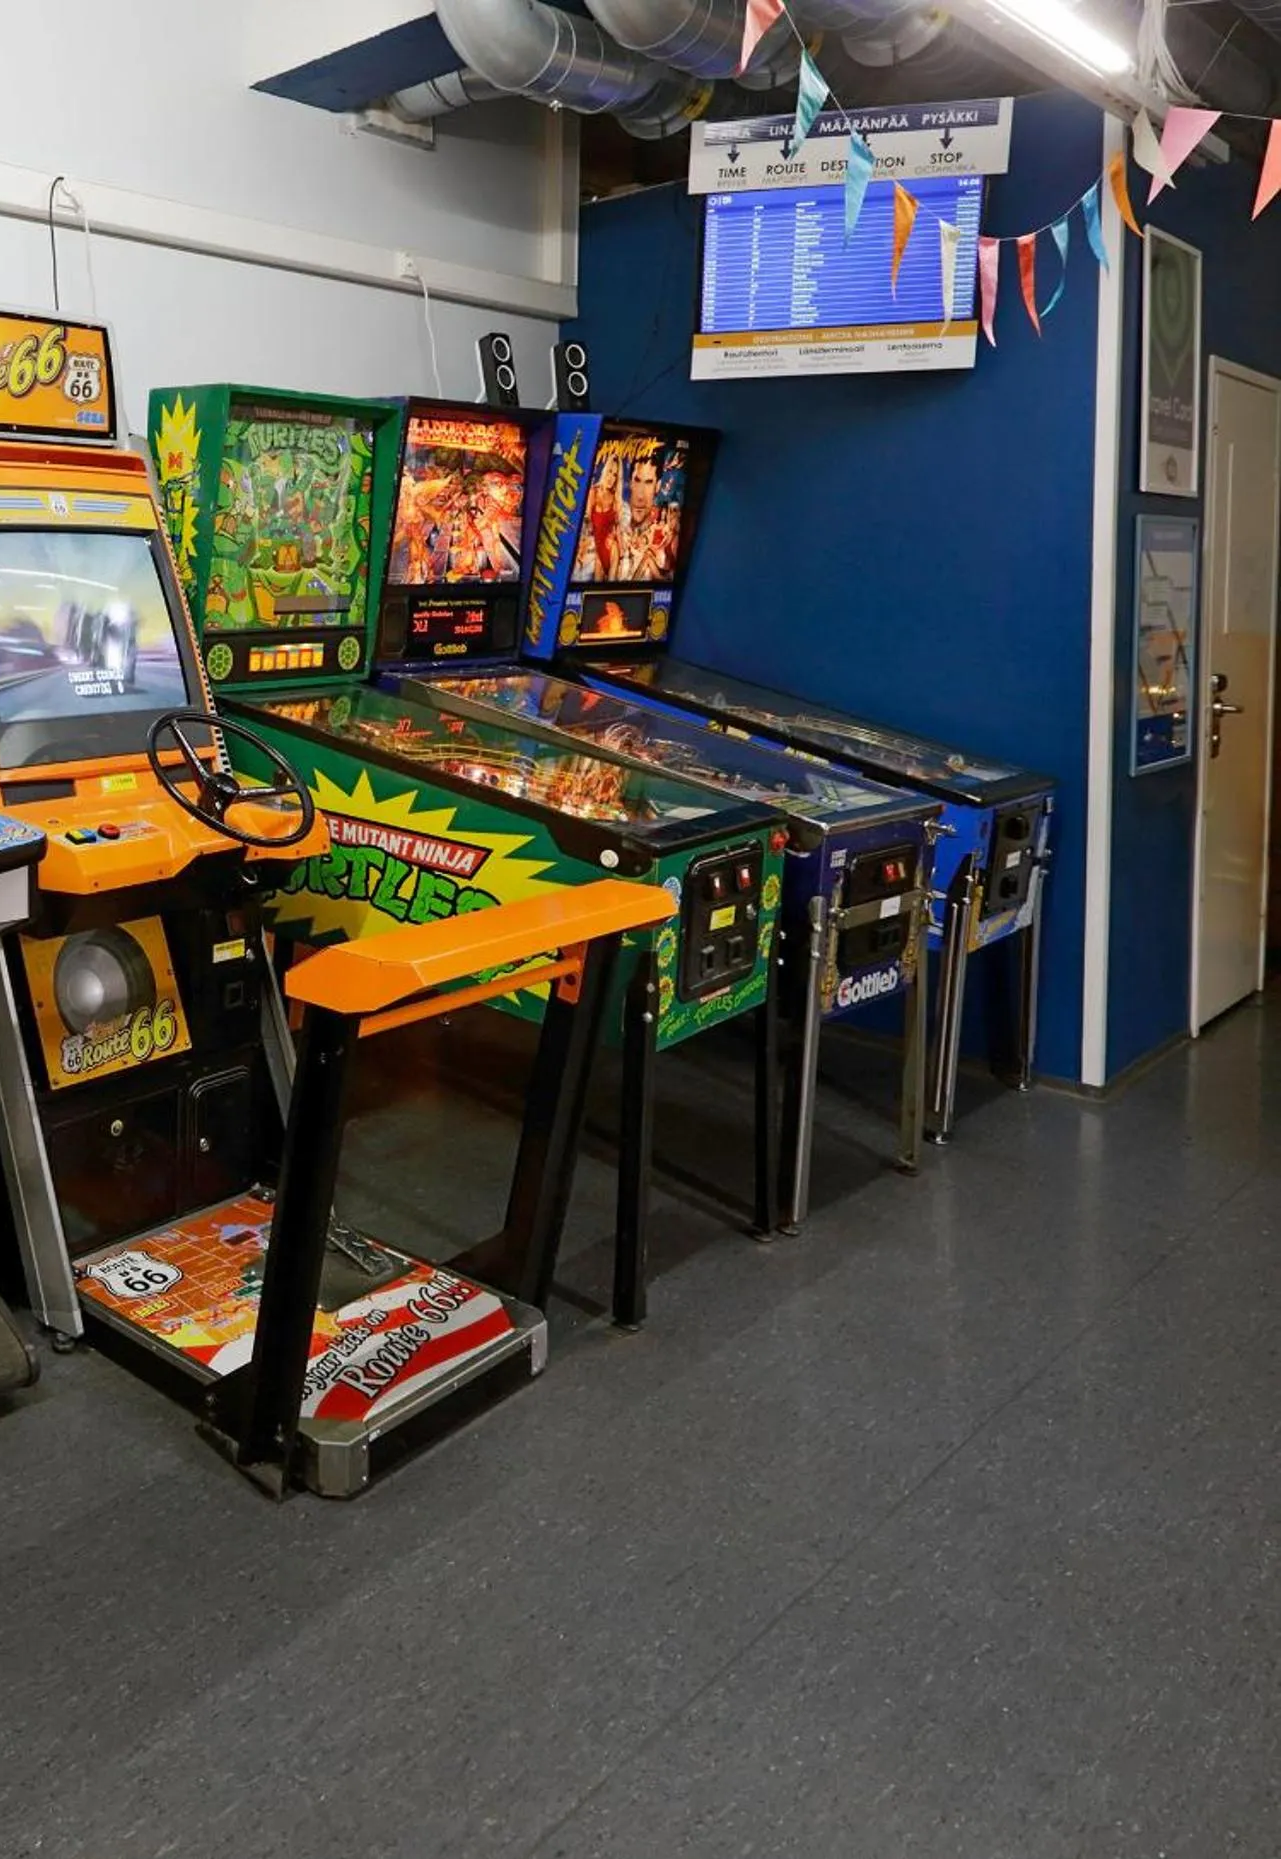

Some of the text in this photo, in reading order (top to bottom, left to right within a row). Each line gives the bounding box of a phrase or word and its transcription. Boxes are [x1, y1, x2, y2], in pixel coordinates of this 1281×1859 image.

[921, 110, 979, 125] PYSÄKKI
[770, 124, 797, 137] LINJ
[821, 156, 906, 172] DESTTION
[930, 152, 964, 164] STOP
[718, 167, 747, 178] TIME
[766, 163, 806, 175] ROUTE
[8, 325, 67, 397] 66
[70, 379, 92, 398] 66
[342, 822, 412, 857] MUTANT
[413, 840, 476, 872] NINJA
[837, 968, 899, 1007] Gottlieb
[81, 1000, 177, 1070] Route 66
[99, 1255, 140, 1274] ROUTE
[123, 1269, 169, 1293] 66
[307, 1308, 389, 1391] your kicks on
[331, 1323, 432, 1400] Route
